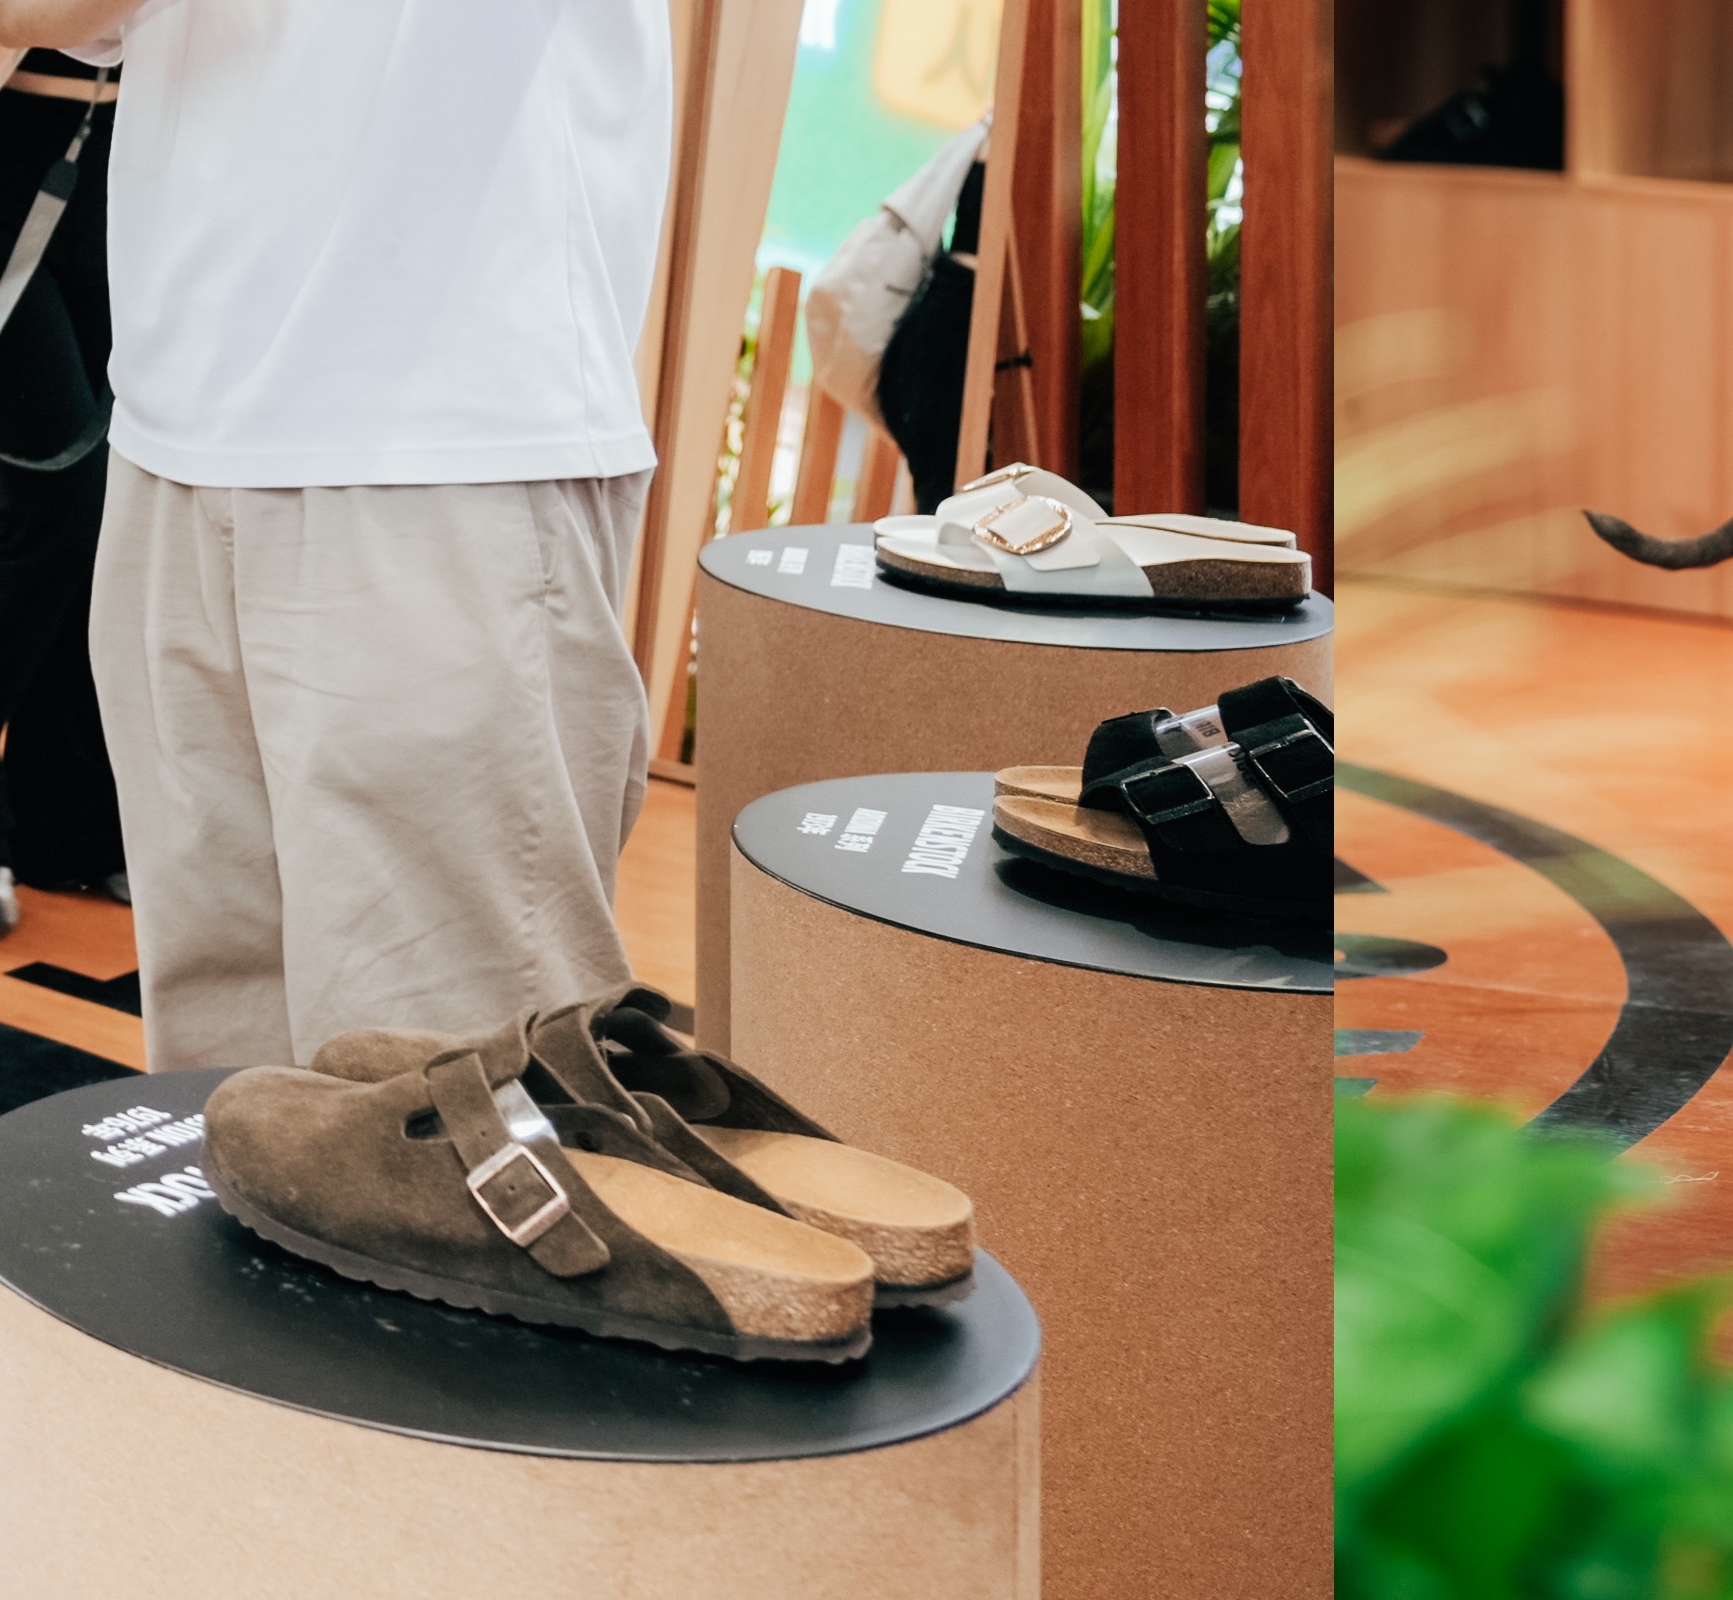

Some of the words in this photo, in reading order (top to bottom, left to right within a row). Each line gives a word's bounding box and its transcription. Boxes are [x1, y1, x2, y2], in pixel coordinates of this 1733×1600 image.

[900, 803, 986, 880] BIRKENSTOCK
[89, 1135, 168, 1168] 系列
[113, 1165, 219, 1219] OCK
